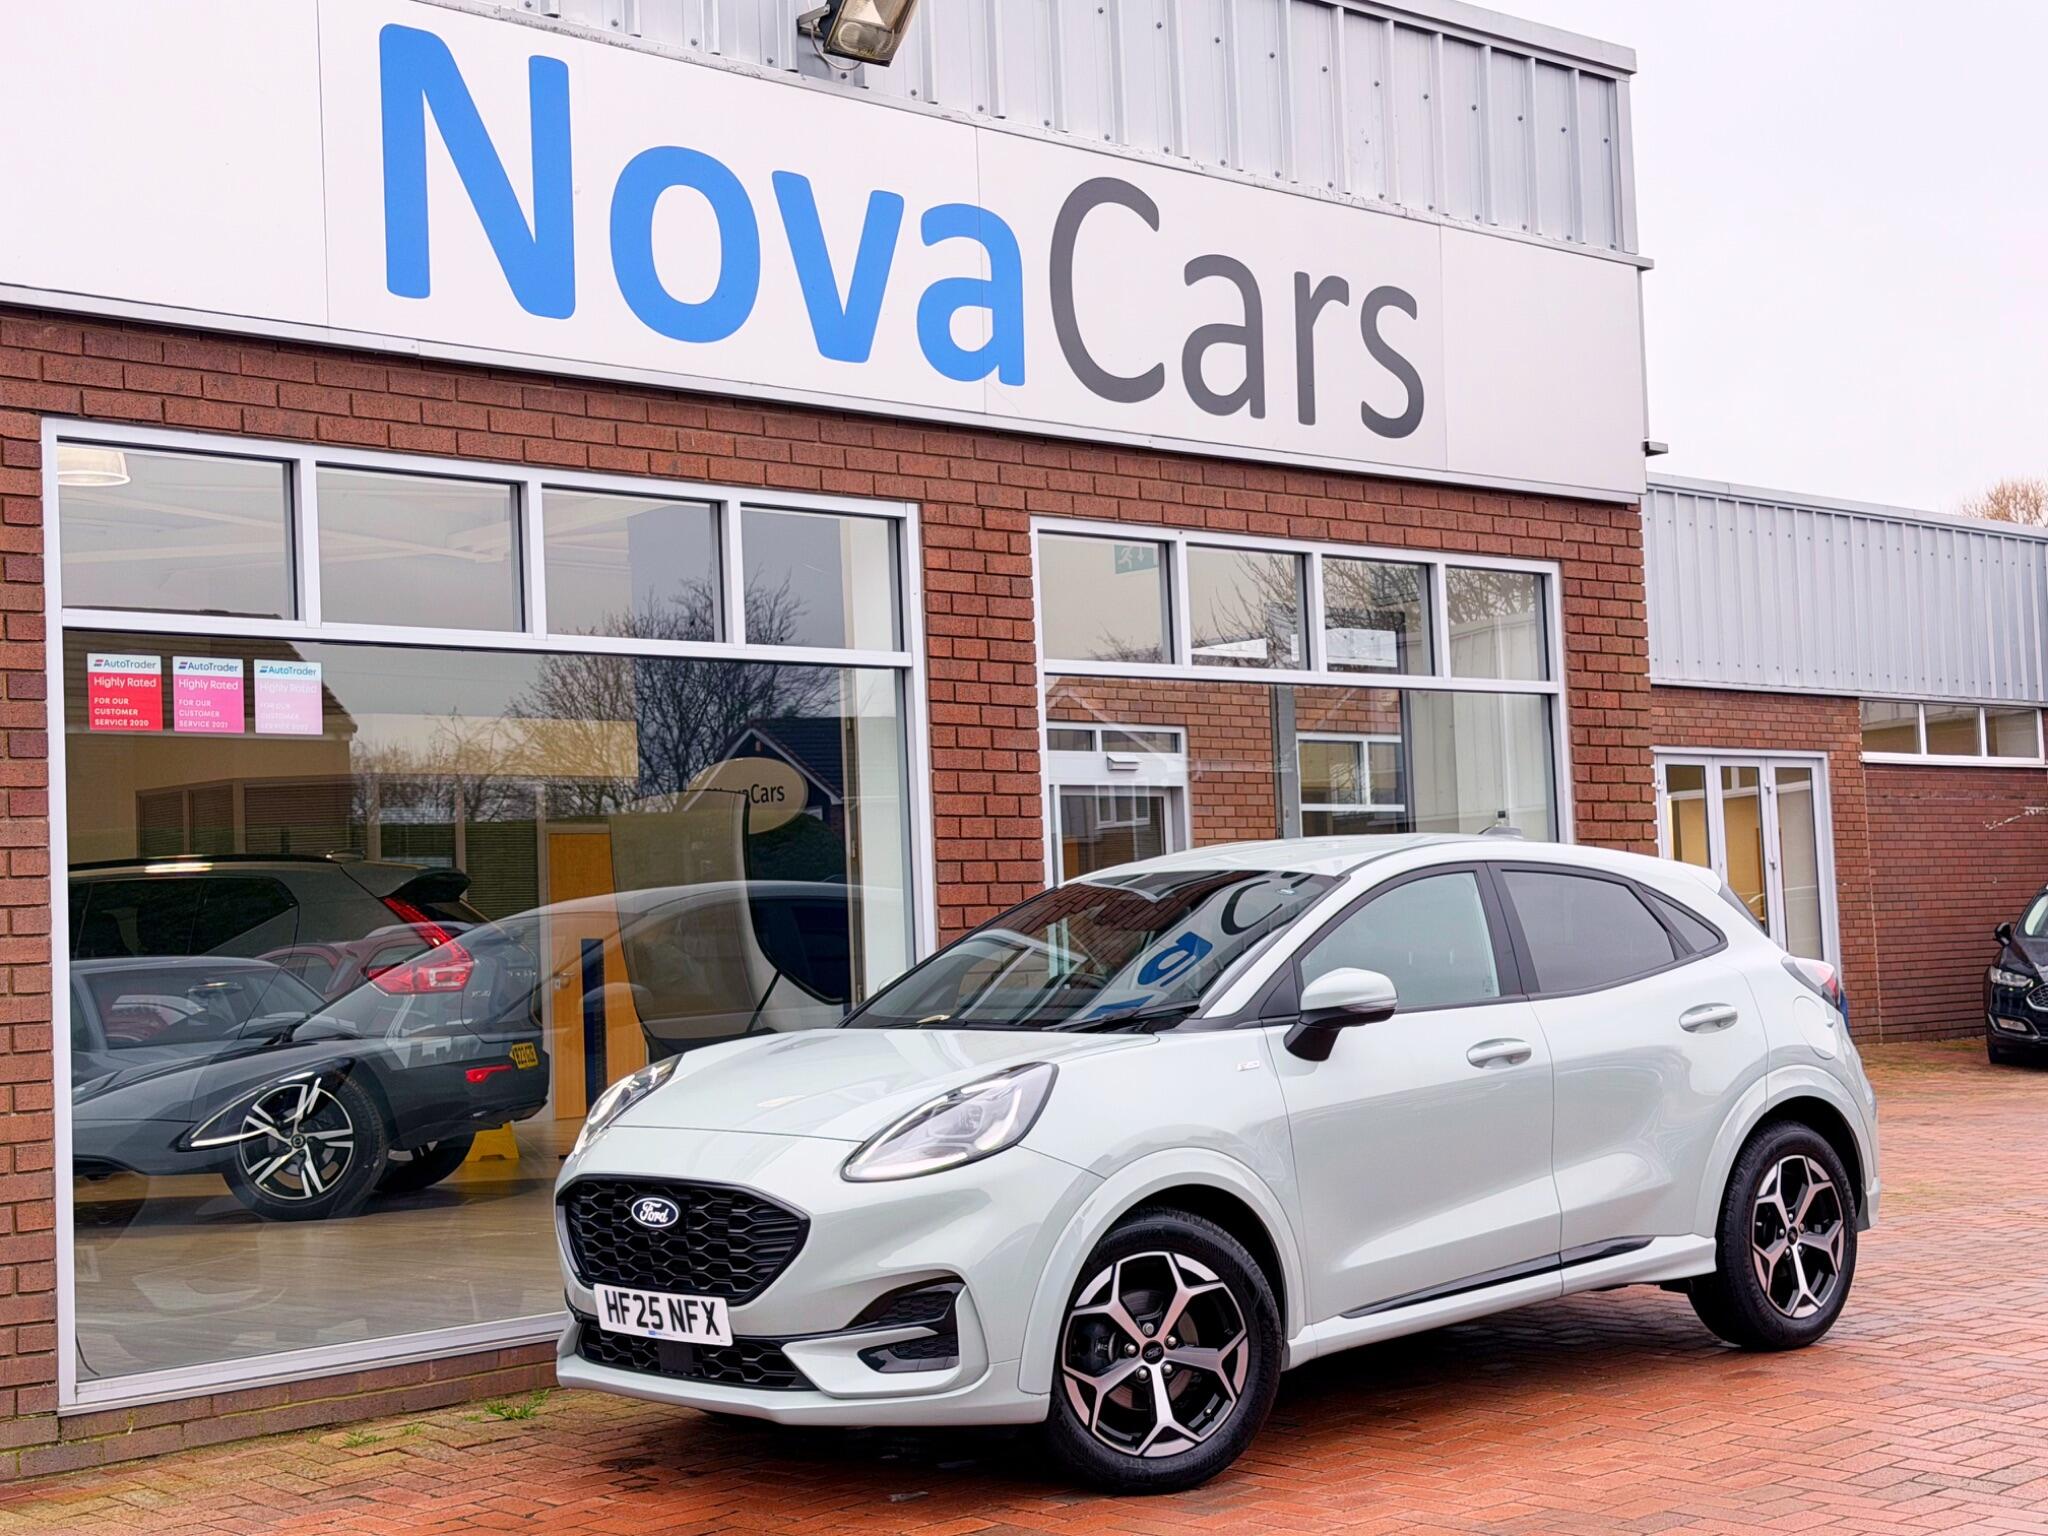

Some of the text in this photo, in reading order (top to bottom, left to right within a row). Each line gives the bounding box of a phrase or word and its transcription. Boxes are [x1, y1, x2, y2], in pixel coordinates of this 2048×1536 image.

[379, 24, 1424, 438] NovaCars
[103, 659, 157, 669] AutoTrader
[187, 662, 239, 672] AutoTrader
[268, 666, 317, 676] AutoTrader
[93, 676, 157, 688] Highly Rated
[178, 679, 239, 691] Highly Rated
[93, 697, 110, 705] FOR
[94, 718, 128, 726] SERVICE
[639, 1200, 669, 1223] Ford
[604, 1289, 720, 1336] HF25 NFX
